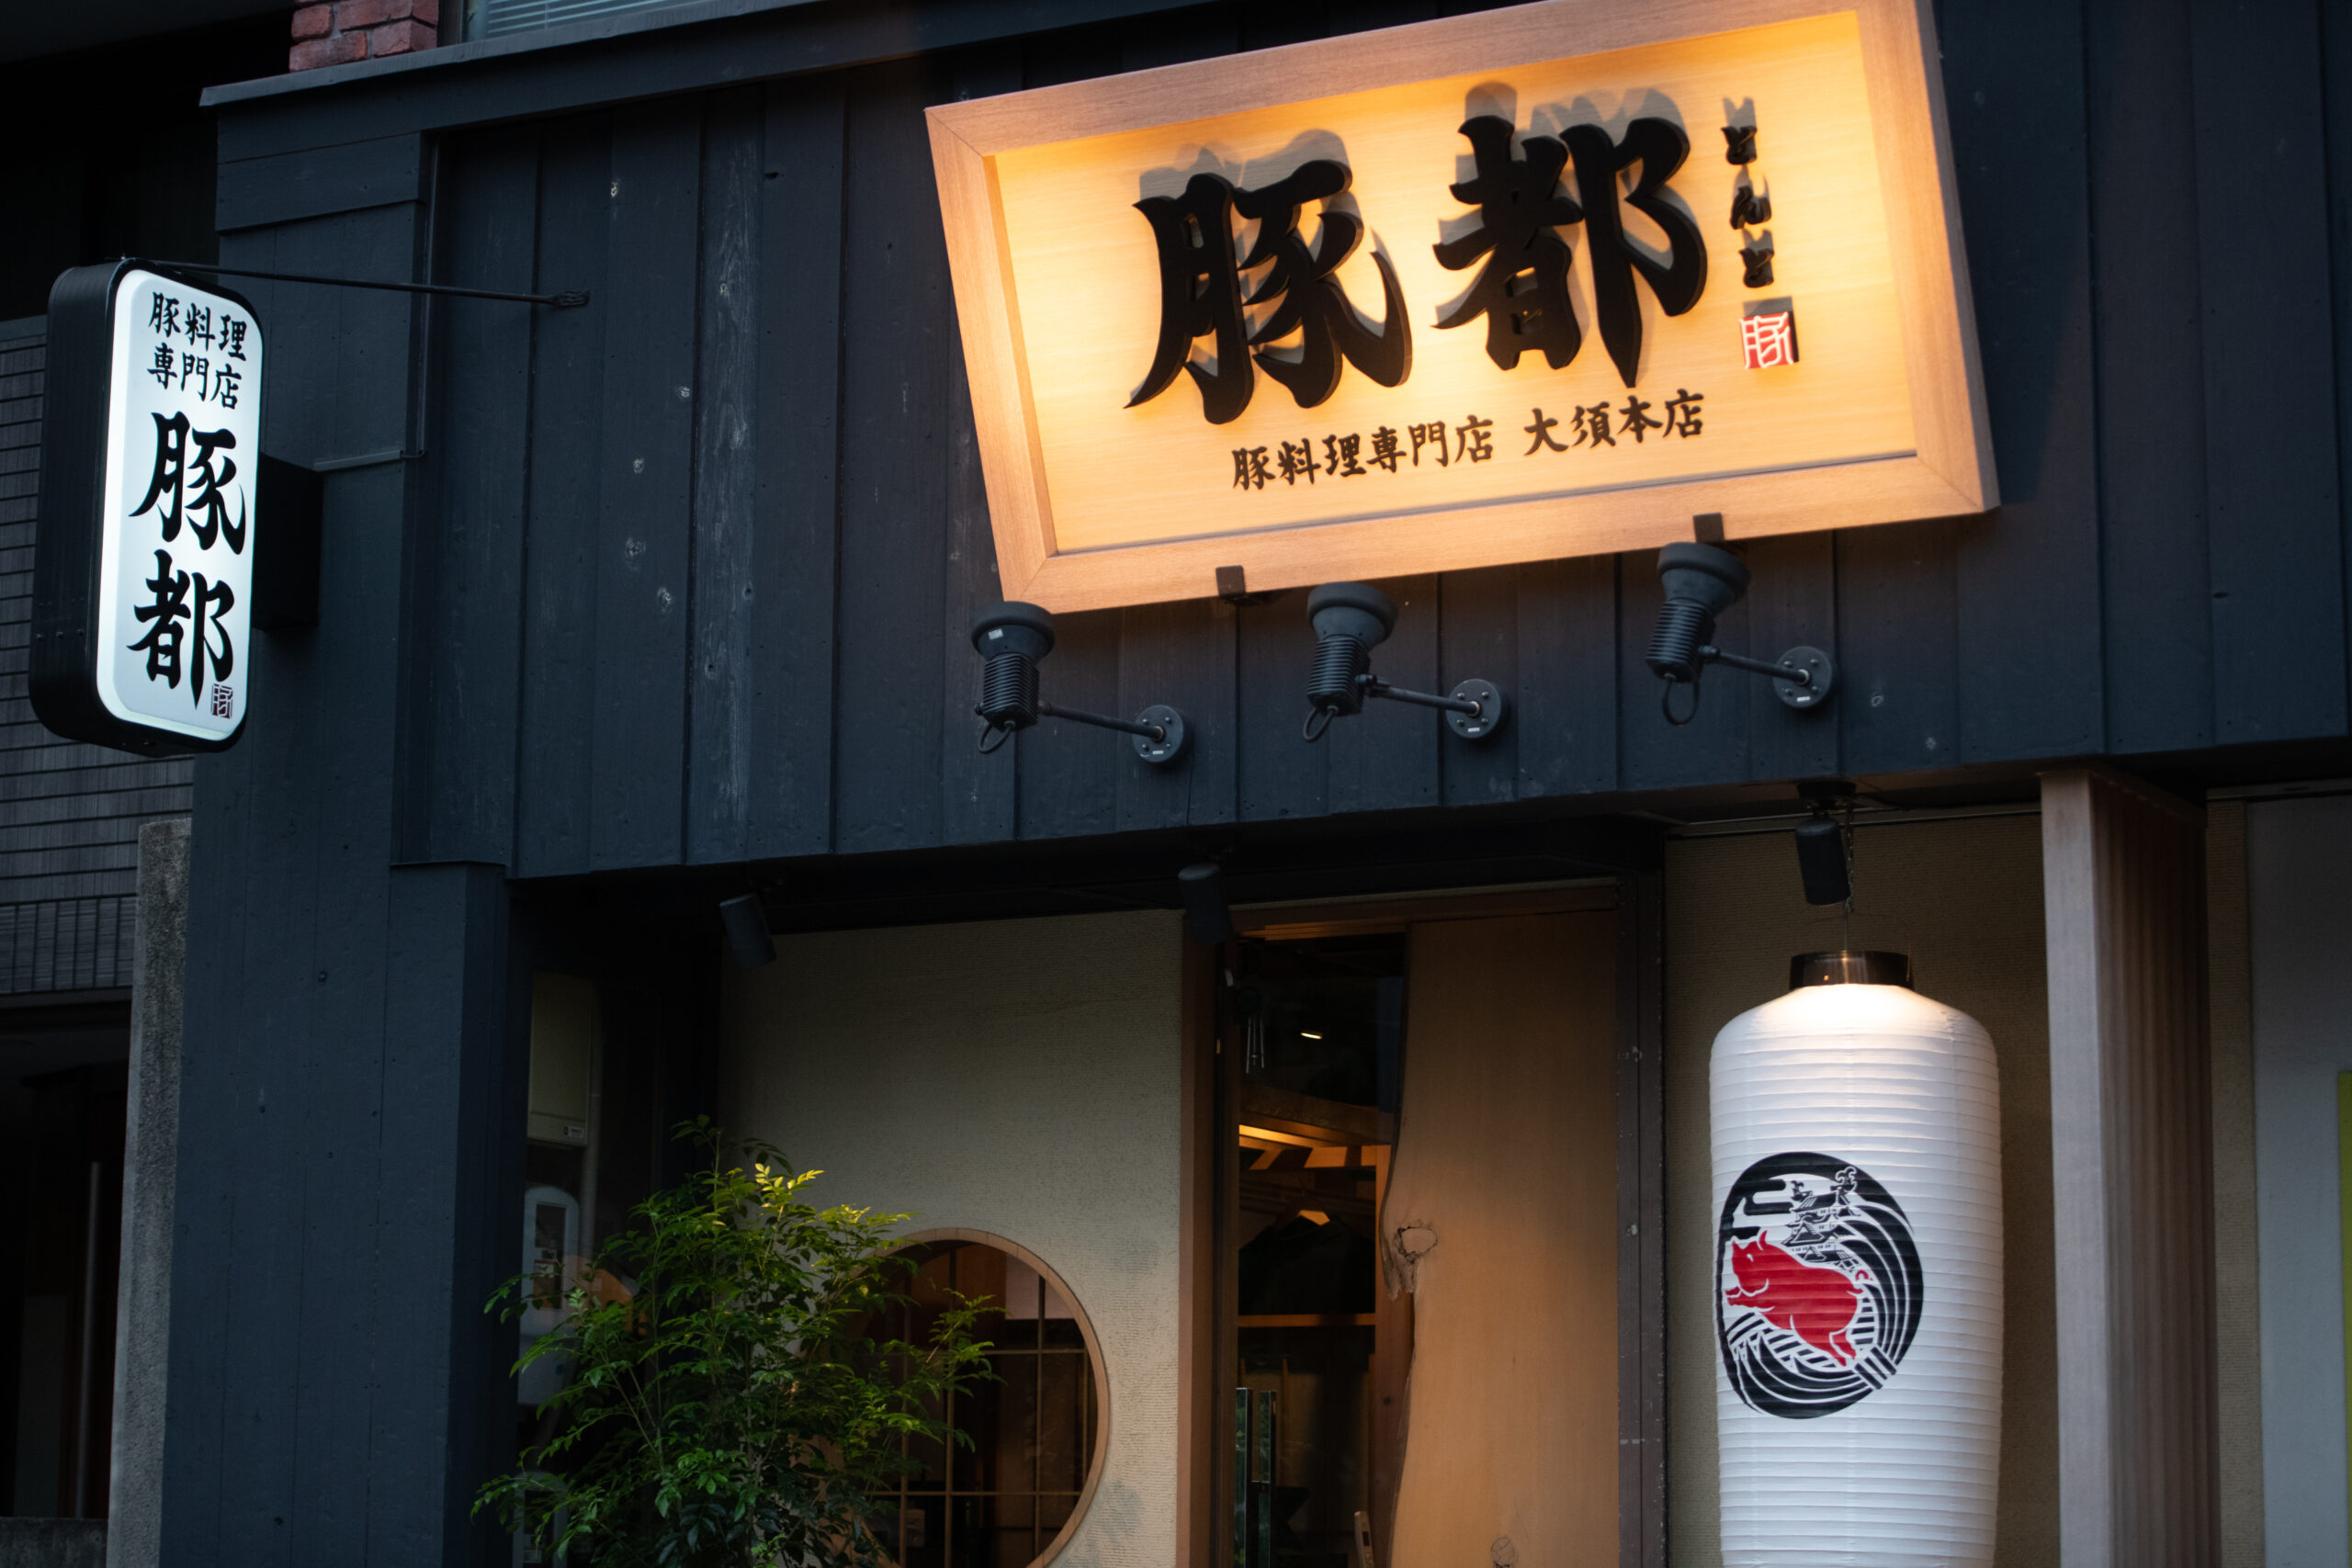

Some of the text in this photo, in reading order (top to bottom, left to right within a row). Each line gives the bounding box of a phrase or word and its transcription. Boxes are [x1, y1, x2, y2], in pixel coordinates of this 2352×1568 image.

[1124, 115, 1707, 424] 豚都
[147, 342, 242, 410] 専門店
[148, 291, 247, 361] 豚料理
[1232, 389, 1704, 491] 豚料理専門店 大須本店
[126, 410, 246, 709] 豚都
